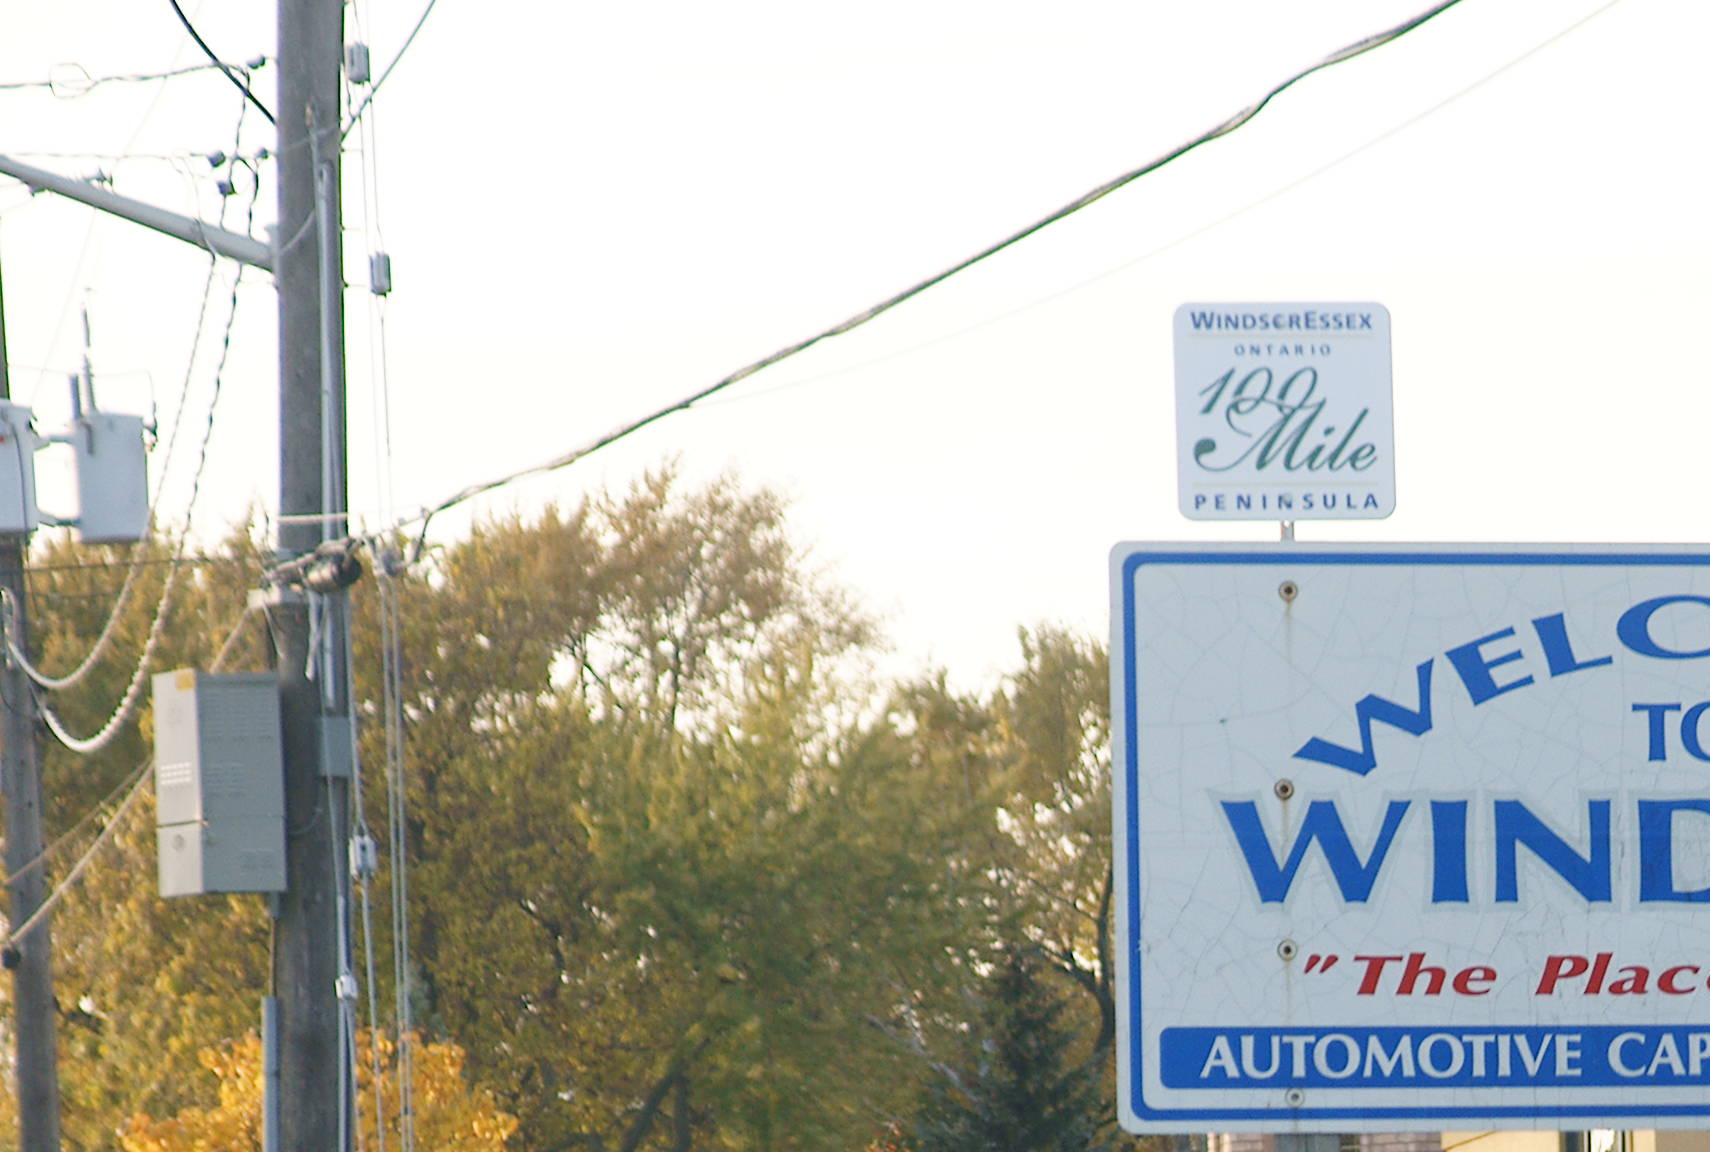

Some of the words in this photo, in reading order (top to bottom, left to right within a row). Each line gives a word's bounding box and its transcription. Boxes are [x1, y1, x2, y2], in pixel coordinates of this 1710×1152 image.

[1234, 343, 1331, 356] ONTARIO
[1199, 365, 1318, 416] 100
[1194, 396, 1378, 472] Mile
[1195, 493, 1379, 510] PENINSULA
[1200, 1034, 1582, 1079] AUTOMOTIVE
